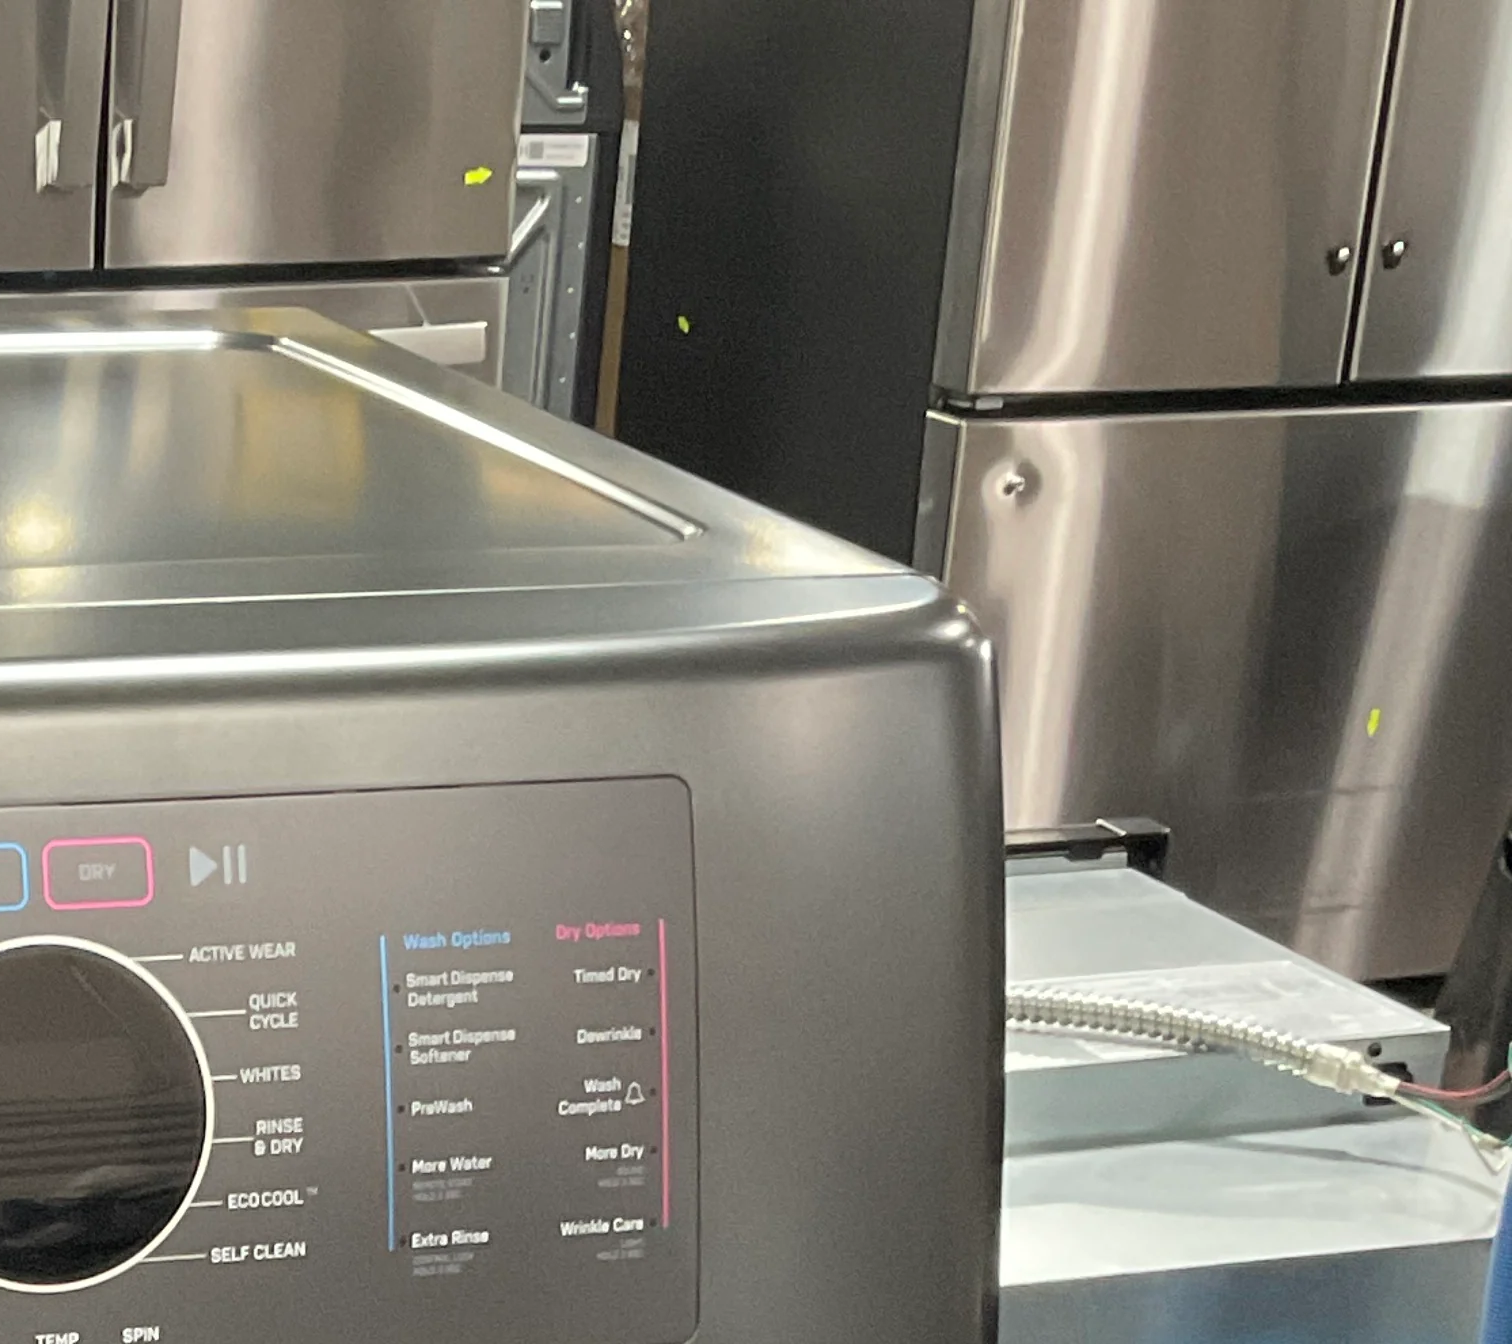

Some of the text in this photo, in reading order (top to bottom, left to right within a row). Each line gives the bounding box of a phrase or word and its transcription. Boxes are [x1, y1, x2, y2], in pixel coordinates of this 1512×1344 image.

[78, 863, 117, 882] DRY
[403, 930, 511, 949] Wash Options
[555, 923, 641, 941] Dry Options
[189, 942, 296, 962] ACTIVE WEAR
[406, 972, 448, 988] Smart
[573, 966, 642, 983] Timed Dry
[249, 992, 298, 1011] QUICK
[407, 989, 479, 1008] Detergent
[249, 1012, 299, 1030] CYCLE
[408, 1031, 450, 1047] Smart
[576, 1026, 642, 1044] Dewrinkle
[410, 1048, 472, 1065] Softener
[240, 1064, 301, 1083] WHITES
[584, 1077, 622, 1093] Wash
[410, 1098, 473, 1116] PreWash
[557, 1098, 622, 1116] Complete
[256, 1117, 304, 1136] RINSE
[270, 1137, 304, 1154] DRY
[585, 1143, 644, 1161] More Dry
[411, 1155, 492, 1174] More Water
[560, 1217, 644, 1237] Wrinkle Care
[411, 1229, 490, 1249] Extra Rinse
[210, 1241, 307, 1264] SELF CLEAN
[121, 1326, 160, 1344] SPIN
